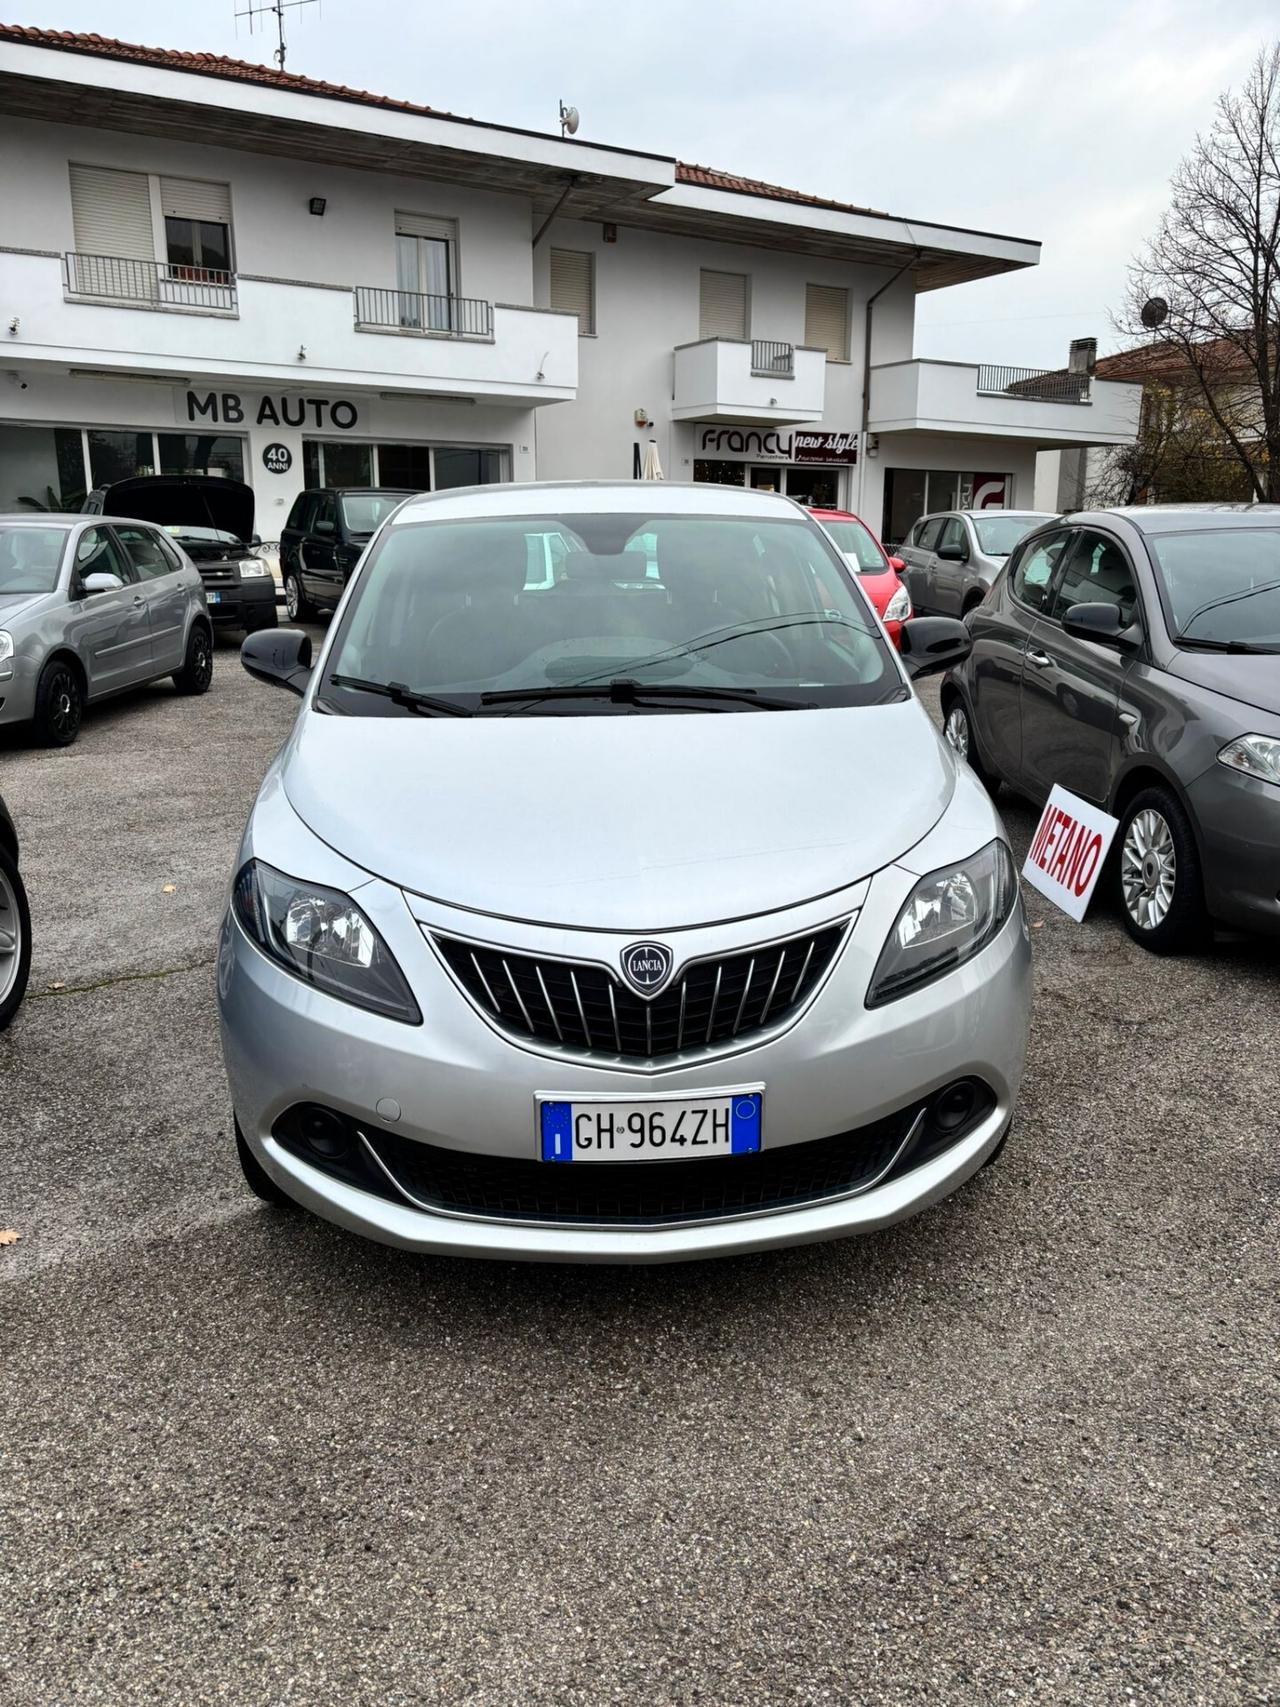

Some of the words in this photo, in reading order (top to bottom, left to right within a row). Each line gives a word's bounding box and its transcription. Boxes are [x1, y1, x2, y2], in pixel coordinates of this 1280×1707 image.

[187, 391, 244, 423] MB
[256, 395, 358, 429] AUTO
[795, 435, 824, 448] new
[823, 433, 858, 454] style
[267, 447, 288, 462] 40
[267, 462, 288, 470] ANNI
[1030, 803, 1102, 897] METANO
[632, 960, 663, 972] LANCIA
